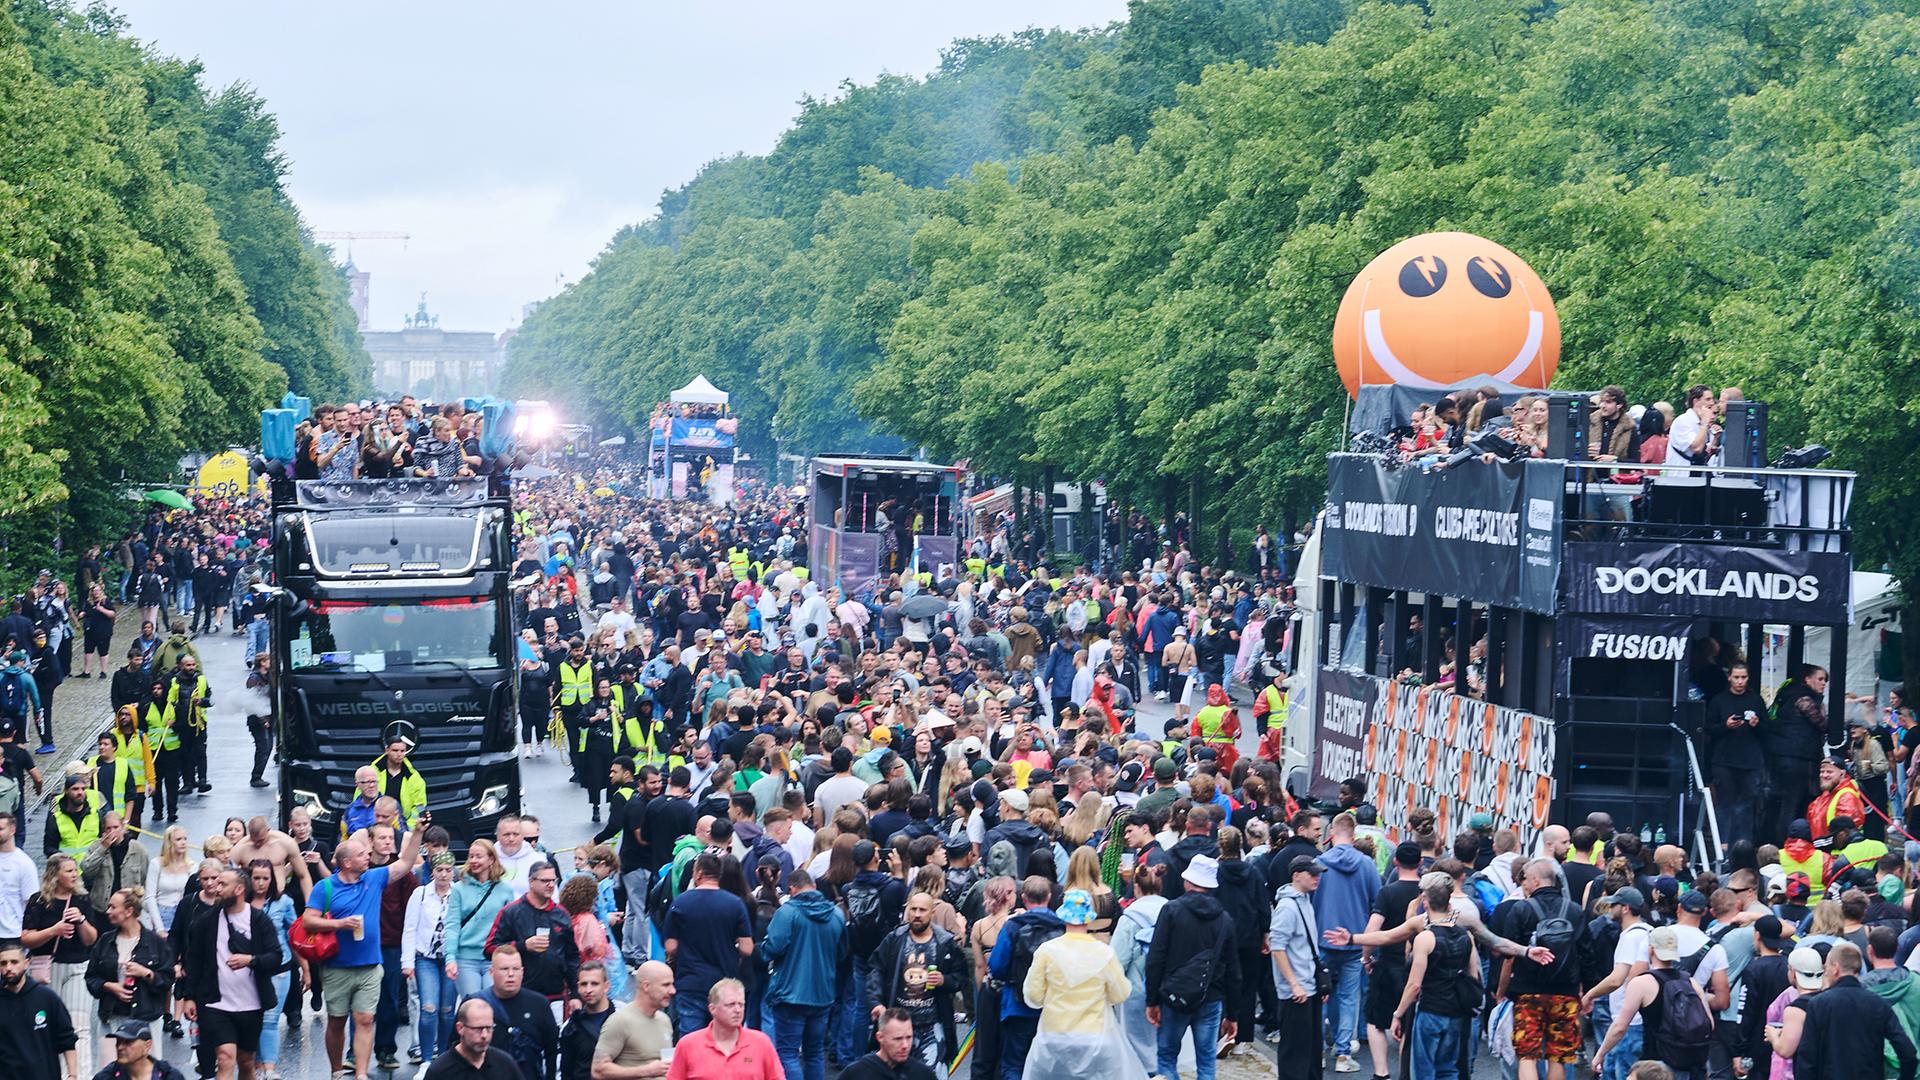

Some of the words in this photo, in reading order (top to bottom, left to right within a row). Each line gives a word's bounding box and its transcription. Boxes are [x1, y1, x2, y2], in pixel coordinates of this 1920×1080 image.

[1435, 506, 1463, 539] CLUBS
[1462, 508, 1481, 542] ARE
[1480, 509, 1519, 546] CULTURE
[1589, 633, 1688, 661] FUSION
[316, 702, 400, 716] WEIGEL
[1323, 690, 1367, 739] ELECTRIFY
[1320, 739, 1361, 784] YOURSELF
